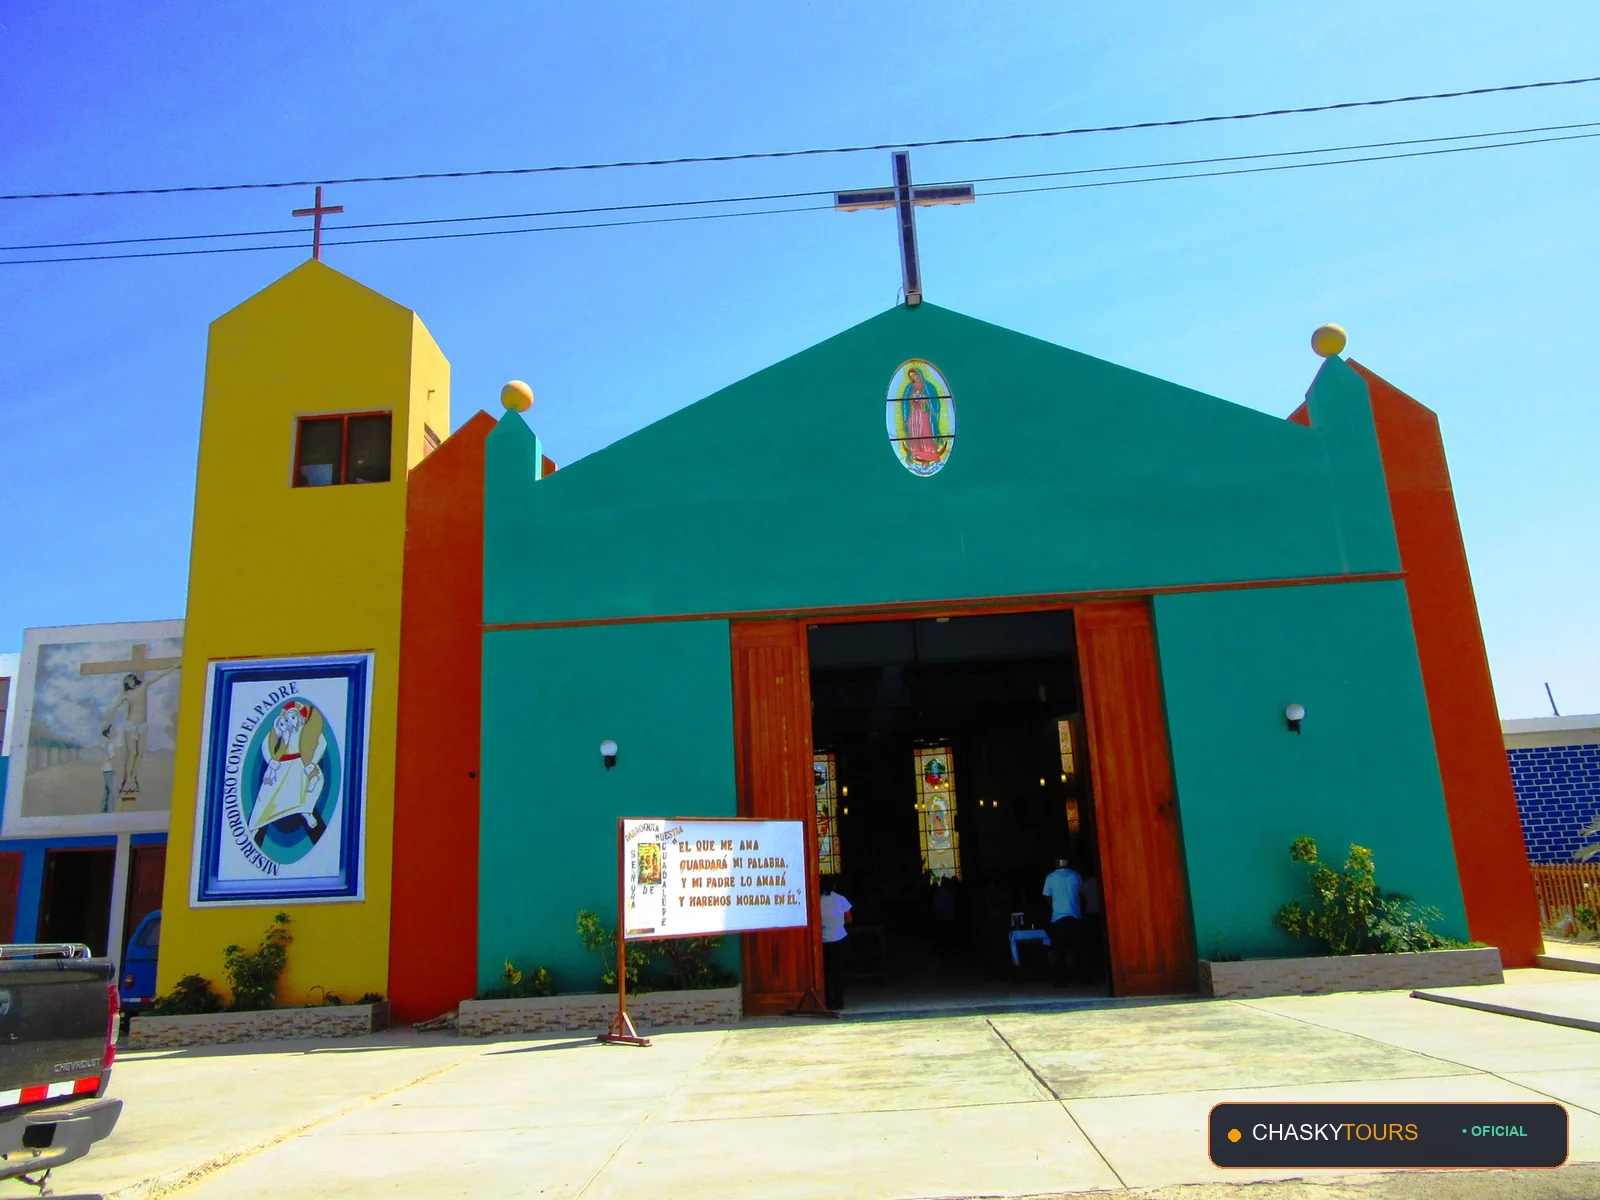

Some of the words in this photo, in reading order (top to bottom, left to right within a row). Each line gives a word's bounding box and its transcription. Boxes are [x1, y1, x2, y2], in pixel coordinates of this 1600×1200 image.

[253, 681, 299, 716] PADRE
[241, 717, 260, 732] EL
[226, 733, 249, 775] COMO
[224, 777, 280, 876] MISERICORDIOSO
[625, 822, 660, 842] PARROQUIA
[696, 839, 715, 852] QUE
[720, 839, 733, 851] ME
[739, 839, 759, 851] AMA
[679, 854, 728, 871] GUARDARÁ
[733, 857, 743, 868] MI
[681, 877, 688, 889] Y
[692, 876, 702, 888] MI
[706, 876, 736, 888] PADRE
[740, 876, 753, 887] LO
[756, 870, 787, 887] AMARÁ
[643, 885, 655, 895] DE
[678, 895, 685, 907] Y
[689, 895, 732, 907] HAREMOS
[736, 894, 771, 906] MORADA
[774, 894, 785, 906] EN
